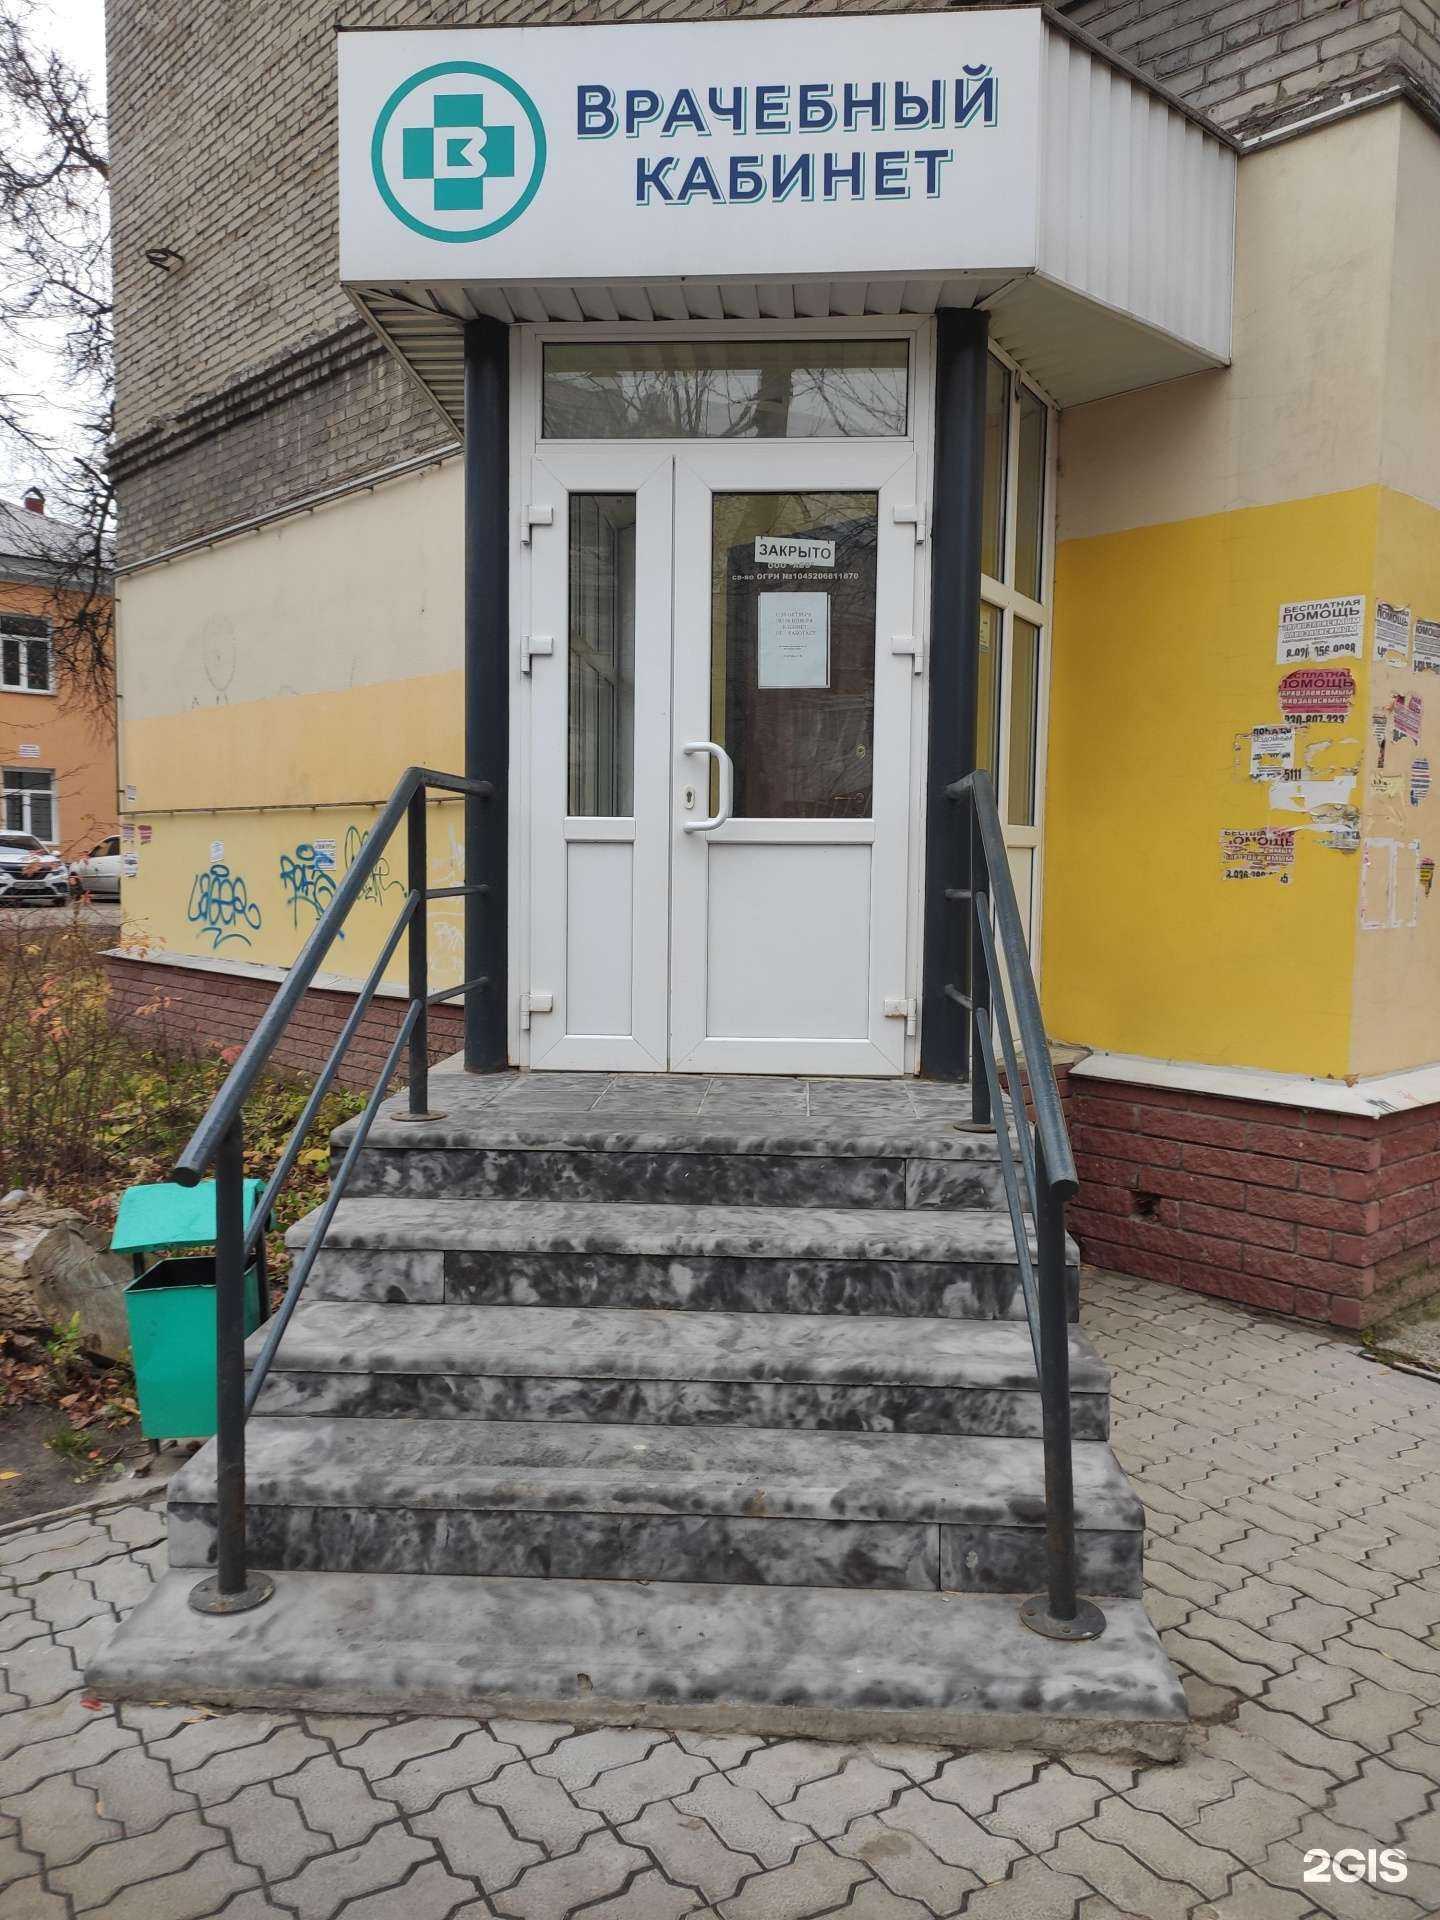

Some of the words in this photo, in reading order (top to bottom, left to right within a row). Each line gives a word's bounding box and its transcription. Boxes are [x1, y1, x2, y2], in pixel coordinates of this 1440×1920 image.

[576, 63, 998, 140] ВРАЧЕБНЫЙ
[635, 148, 954, 206] КАБИНЕТ
[759, 543, 831, 560] ЗАКРЫТО
[1282, 607, 1360, 623] ПОМОЩЬ
[1284, 599, 1361, 614] БЕСПЛАТНАЯ
